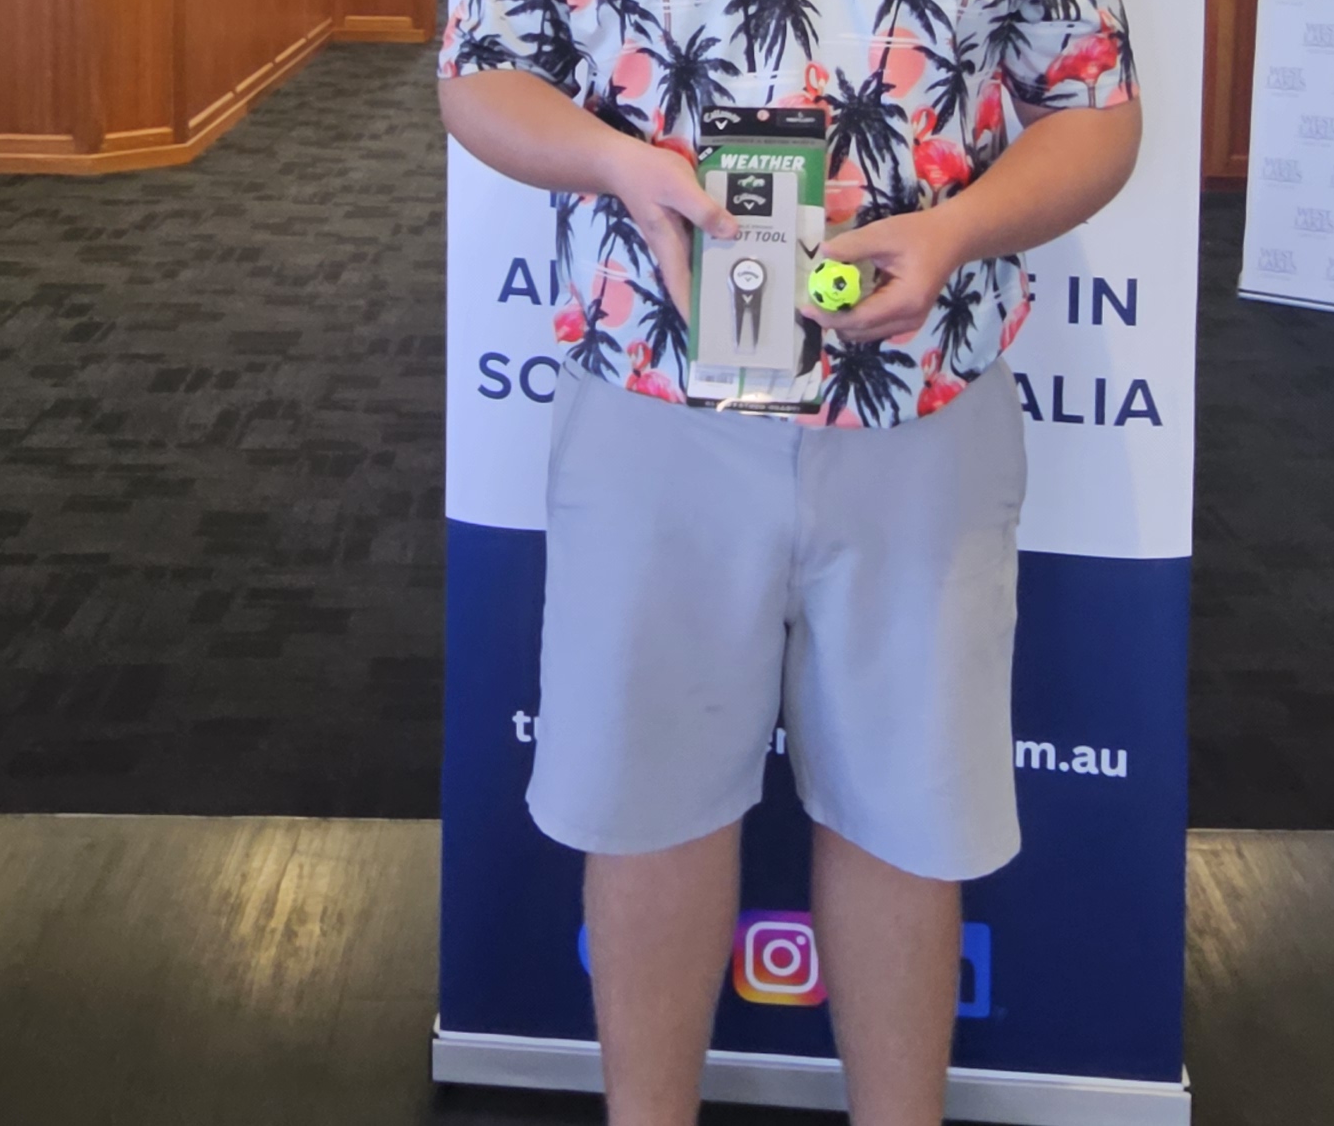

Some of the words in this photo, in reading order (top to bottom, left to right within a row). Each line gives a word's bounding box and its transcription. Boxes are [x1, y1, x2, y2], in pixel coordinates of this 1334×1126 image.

[720, 154, 806, 171] WEATHER
[755, 231, 787, 243] TOOL
[1068, 276, 1138, 326] IN
[1012, 372, 1163, 426] ALIA
